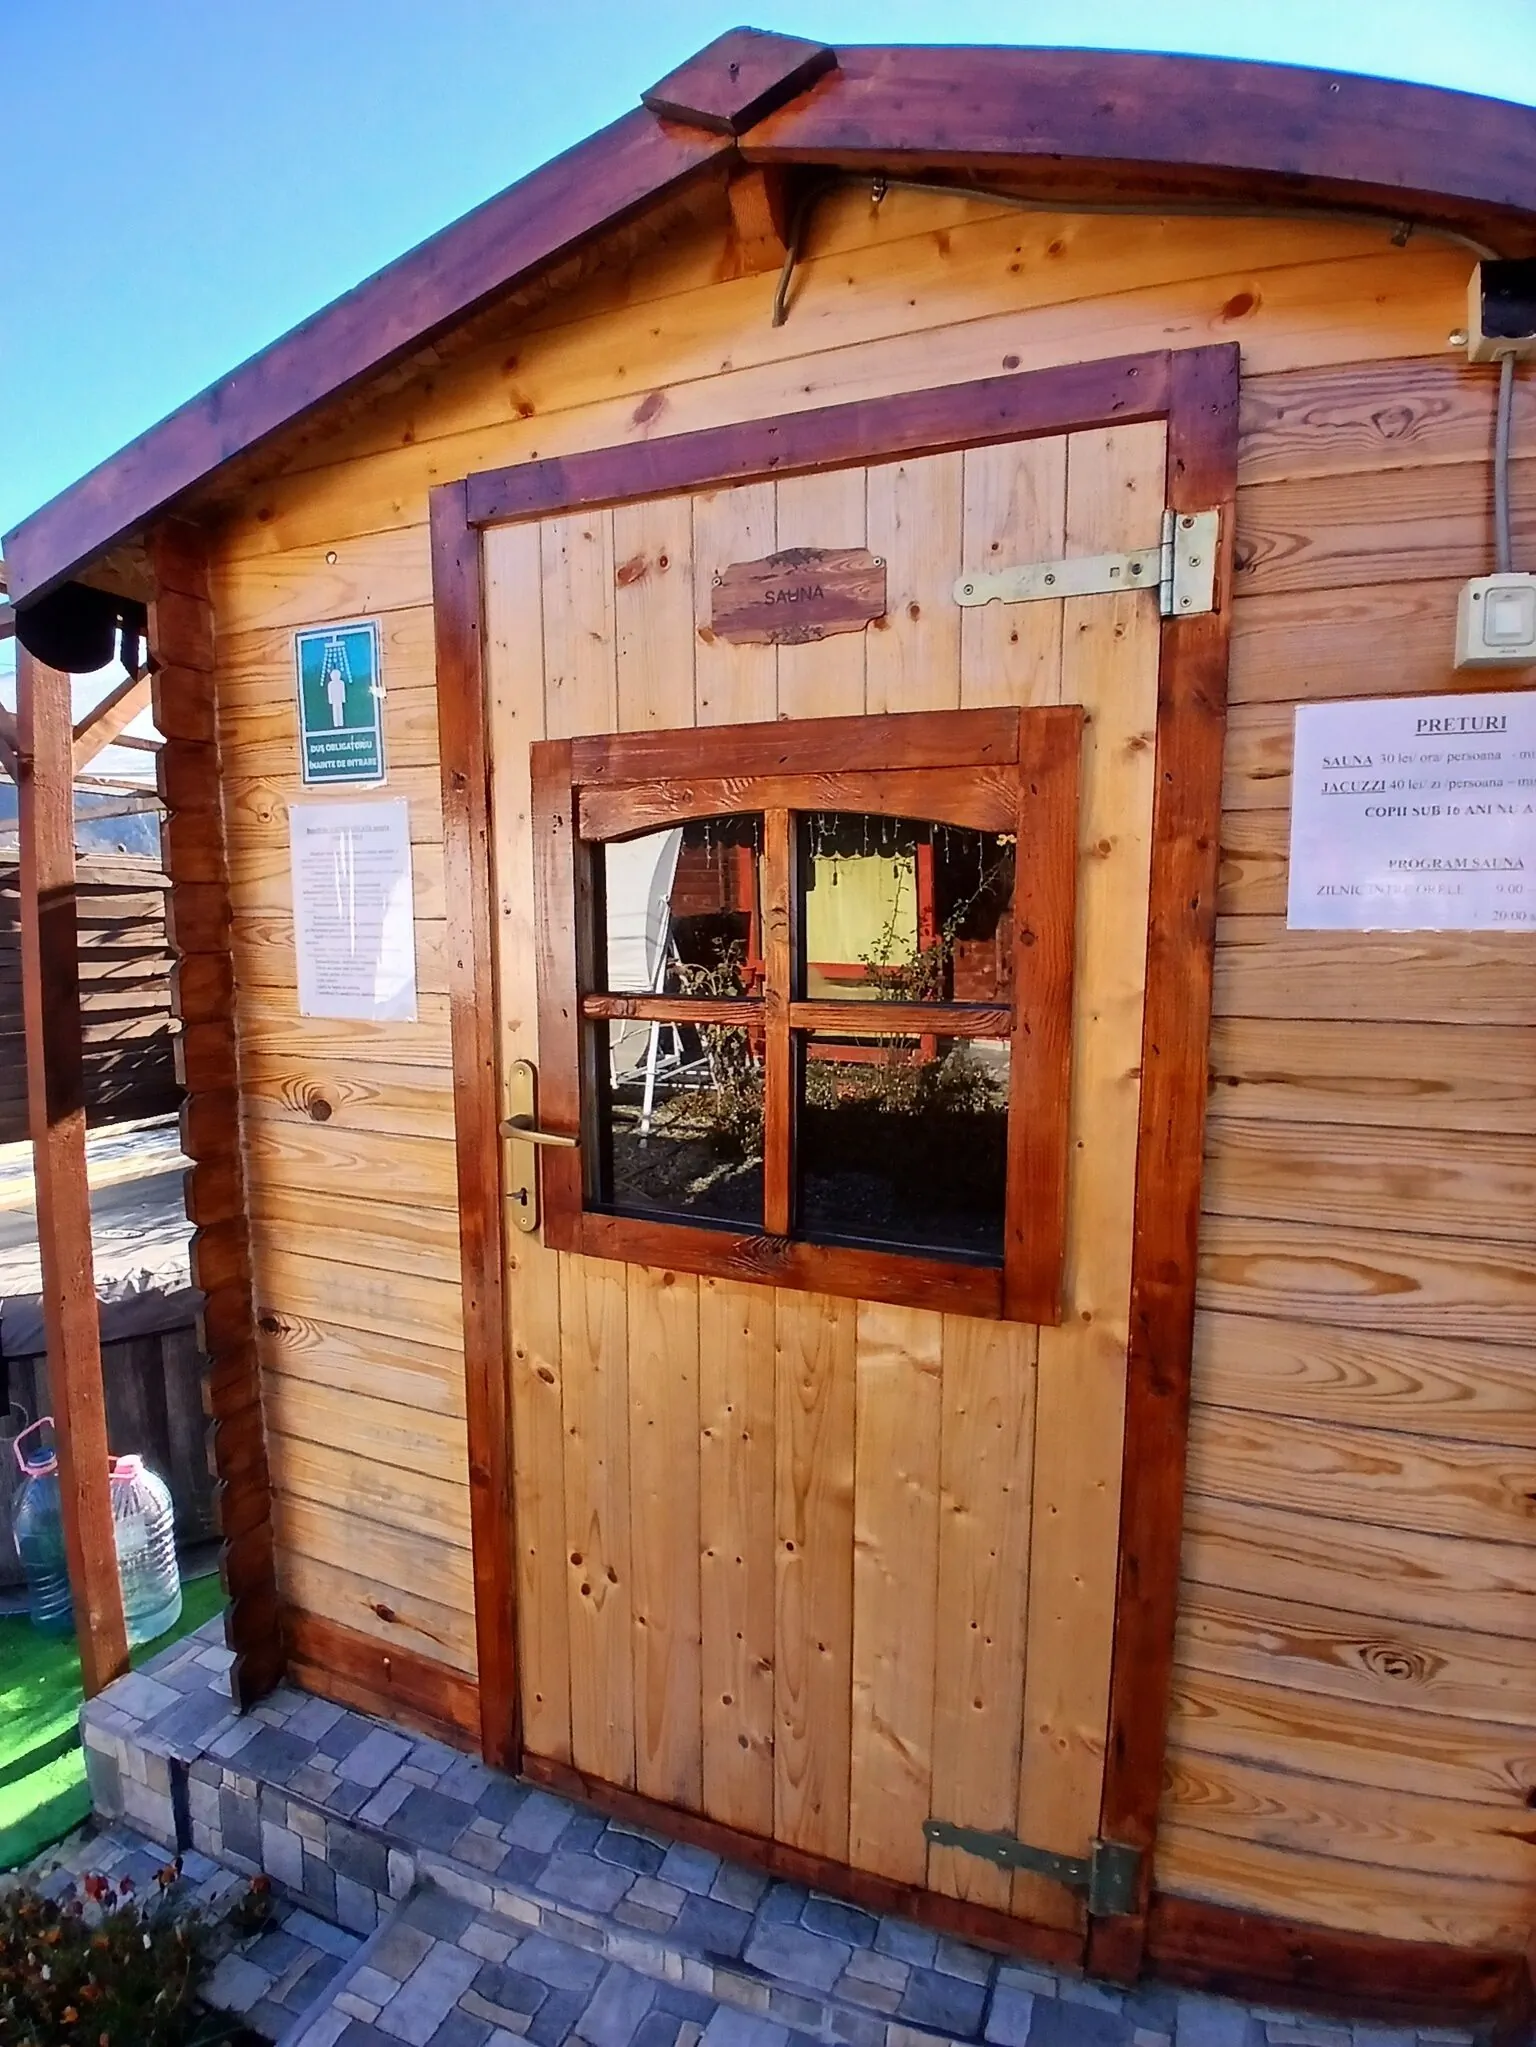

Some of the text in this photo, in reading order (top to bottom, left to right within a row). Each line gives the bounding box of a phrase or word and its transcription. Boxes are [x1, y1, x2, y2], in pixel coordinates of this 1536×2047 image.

[764, 586, 825, 605] SAUNA
[1415, 715, 1507, 735] PRETURI
[336, 759, 346, 768] DE
[346, 757, 377, 768] INTRARE
[1322, 755, 1373, 768] SAUNA
[1380, 753, 1395, 764] 30
[1321, 780, 1386, 795] JACUZZI
[1389, 779, 1405, 790] 40
[1364, 806, 1407, 817] COPII
[1412, 804, 1441, 816] SUB
[1446, 805, 1460, 816] 16
[1465, 803, 1492, 815] ANI
[1388, 856, 1524, 872] PROGRAM SAUNA
[1317, 884, 1363, 896] ZILNIC
